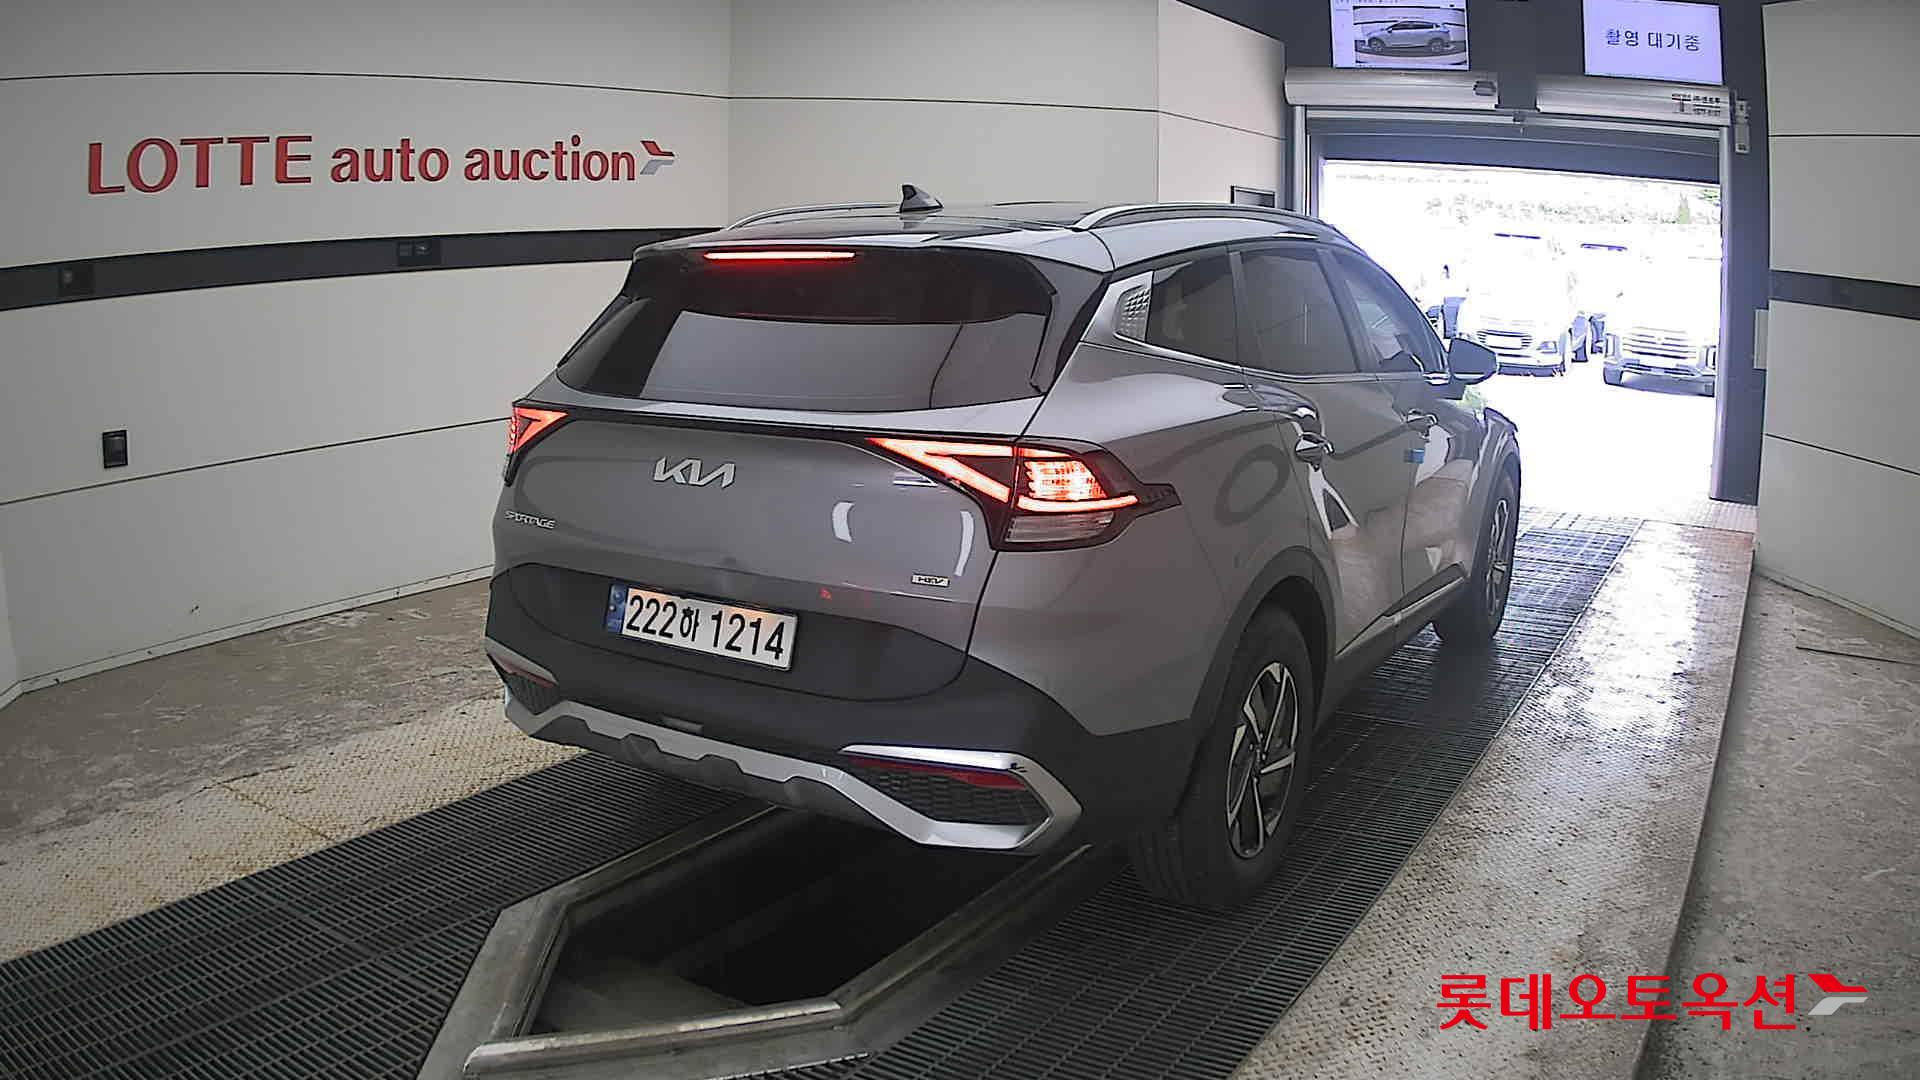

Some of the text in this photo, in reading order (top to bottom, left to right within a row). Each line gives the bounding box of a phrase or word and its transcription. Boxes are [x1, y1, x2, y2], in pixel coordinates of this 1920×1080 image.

[1647, 32, 1701, 52] 대기중
[87, 135, 637, 195] LOTTE auto auction
[653, 457, 735, 489] KIA
[626, 595, 785, 660] 222하 1214
